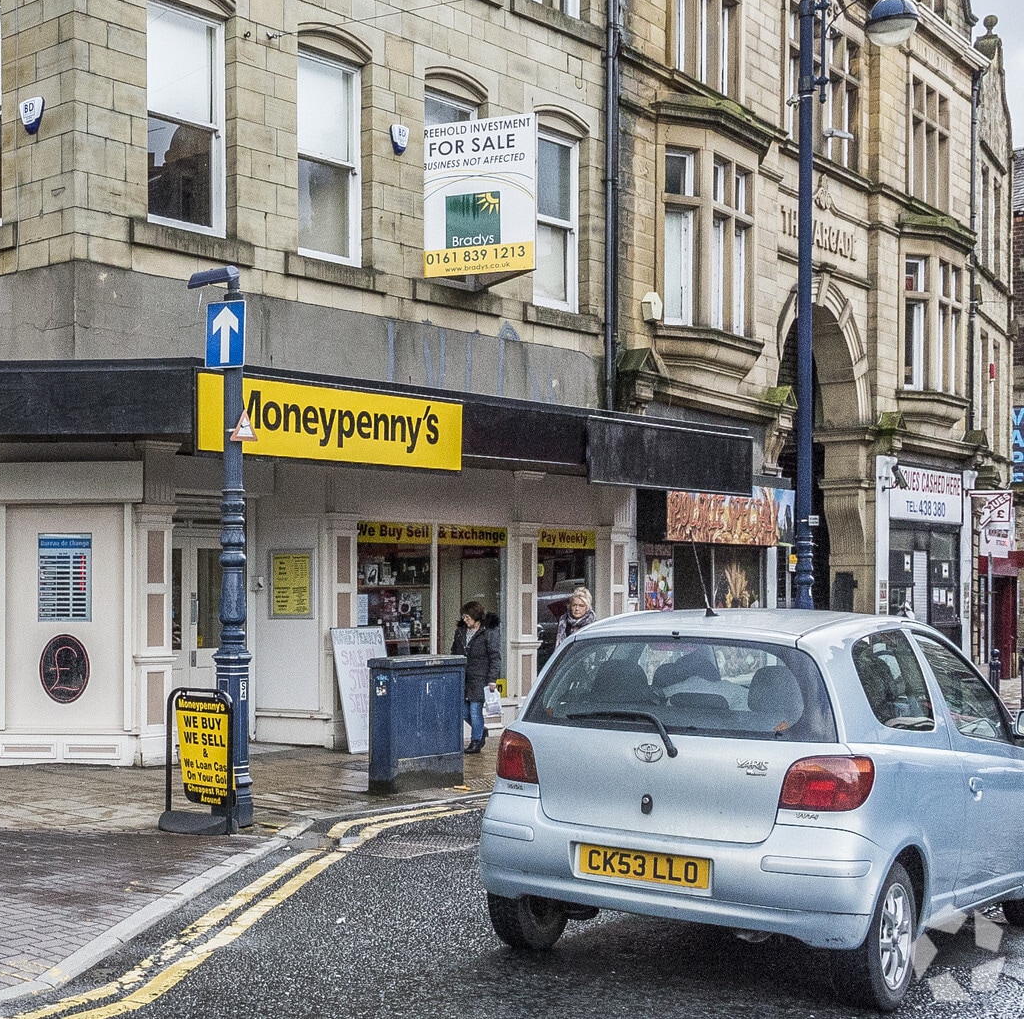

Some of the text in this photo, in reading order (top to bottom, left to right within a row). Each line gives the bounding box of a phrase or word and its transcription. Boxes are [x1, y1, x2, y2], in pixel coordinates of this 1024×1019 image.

[423, 117, 531, 139] REEHOLD INVESTMENT
[429, 133, 516, 157] FOR SALE
[462, 157, 481, 167] NOT
[483, 152, 526, 165] AFFECTED
[452, 233, 495, 247] Bradys
[781, 205, 857, 261] TH ARCADE
[426, 245, 526, 266] 0161 839 1213
[445, 261, 511, 273] www.bradys.co.uk
[921, 472, 945, 493] CASHED
[946, 477, 961, 496] HERE
[919, 500, 932, 516] 438
[933, 502, 946, 517] 380
[357, 523, 506, 543] We Buy Sell & Exchange
[541, 531, 588, 545] Pay Weekly
[178, 698, 225, 713] Moneypenny's
[183, 715, 222, 731] WE BUY
[183, 731, 226, 748] WE SELL
[203, 748, 208, 758] &
[183, 757, 227, 772] We Loan Cas
[186, 770, 227, 784] On Your Gol
[187, 784, 215, 795] Cheapest
[200, 794, 222, 805] Around
[588, 849, 698, 884] CK53 LLO
